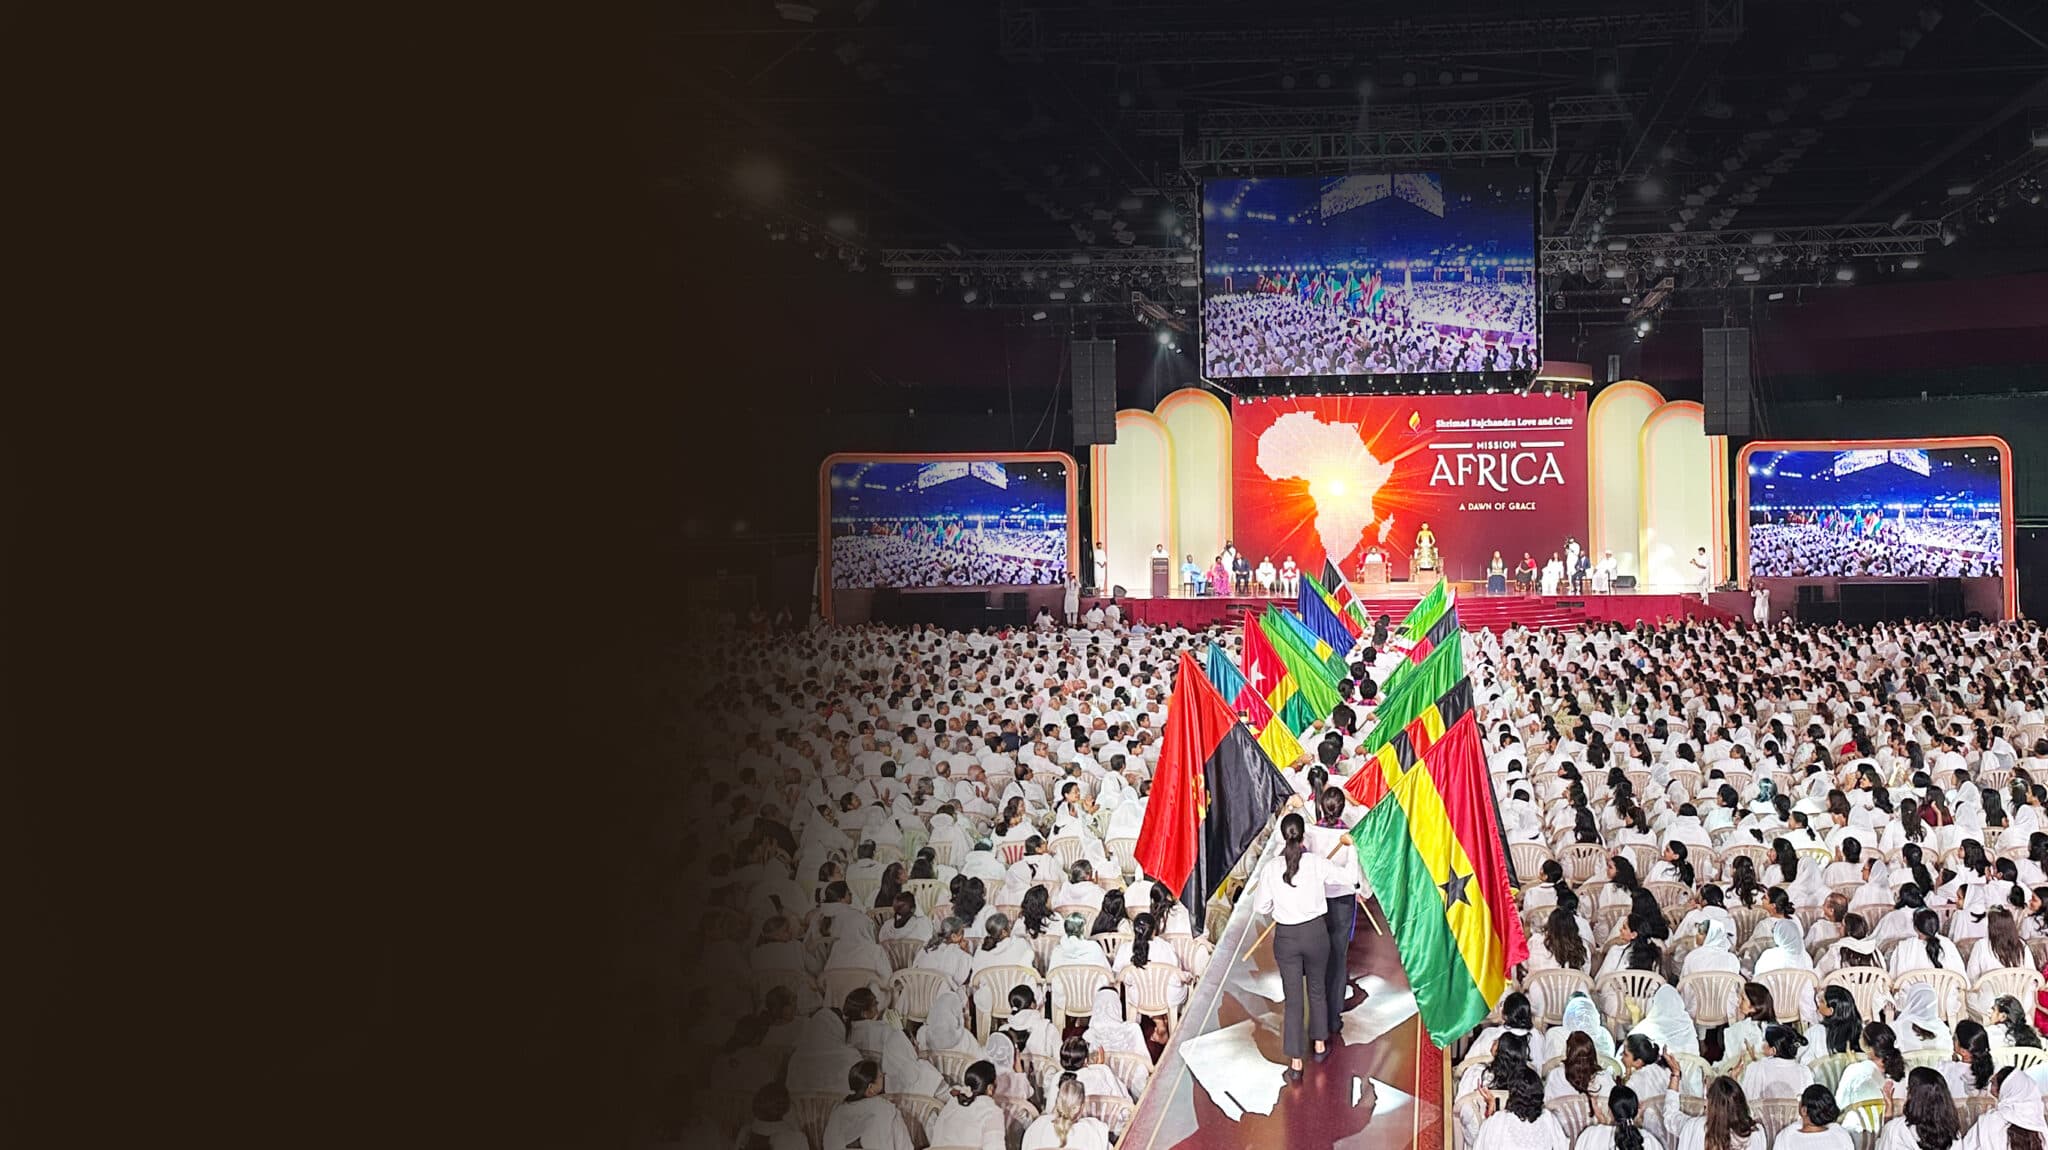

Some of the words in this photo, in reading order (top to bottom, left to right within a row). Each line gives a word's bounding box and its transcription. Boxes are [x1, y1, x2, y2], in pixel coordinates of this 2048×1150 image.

[1436, 419, 1470, 428] Shrimad
[1471, 418, 1516, 429] Rajchandra
[1517, 418, 1537, 427] Love
[1538, 417, 1553, 426] and
[1554, 417, 1573, 426] Care
[1476, 441, 1517, 450] MISSION
[1429, 452, 1565, 492] AFRICA
[1459, 503, 1466, 511] A
[1468, 502, 1492, 511] DAWN
[1494, 502, 1506, 511] OF
[1508, 502, 1536, 511] GRACE
